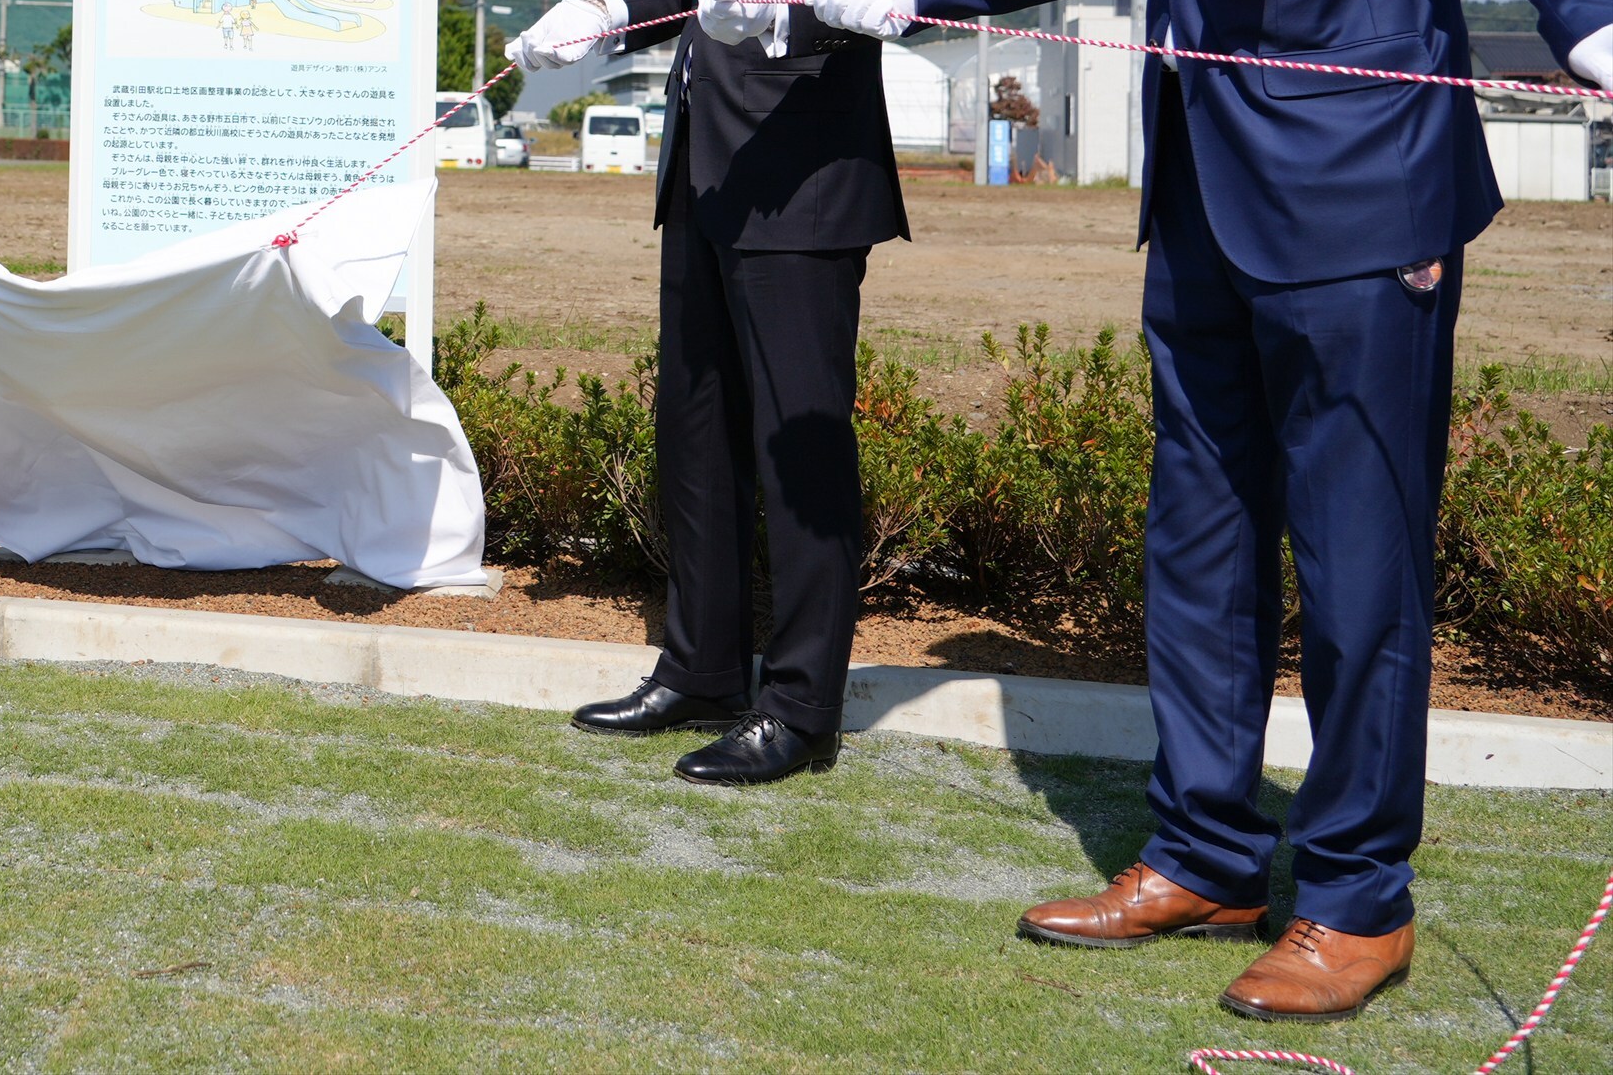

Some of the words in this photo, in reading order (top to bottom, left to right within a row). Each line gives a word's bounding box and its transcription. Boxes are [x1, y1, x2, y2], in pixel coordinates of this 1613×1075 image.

[104, 98, 155, 109] 設置しました。
